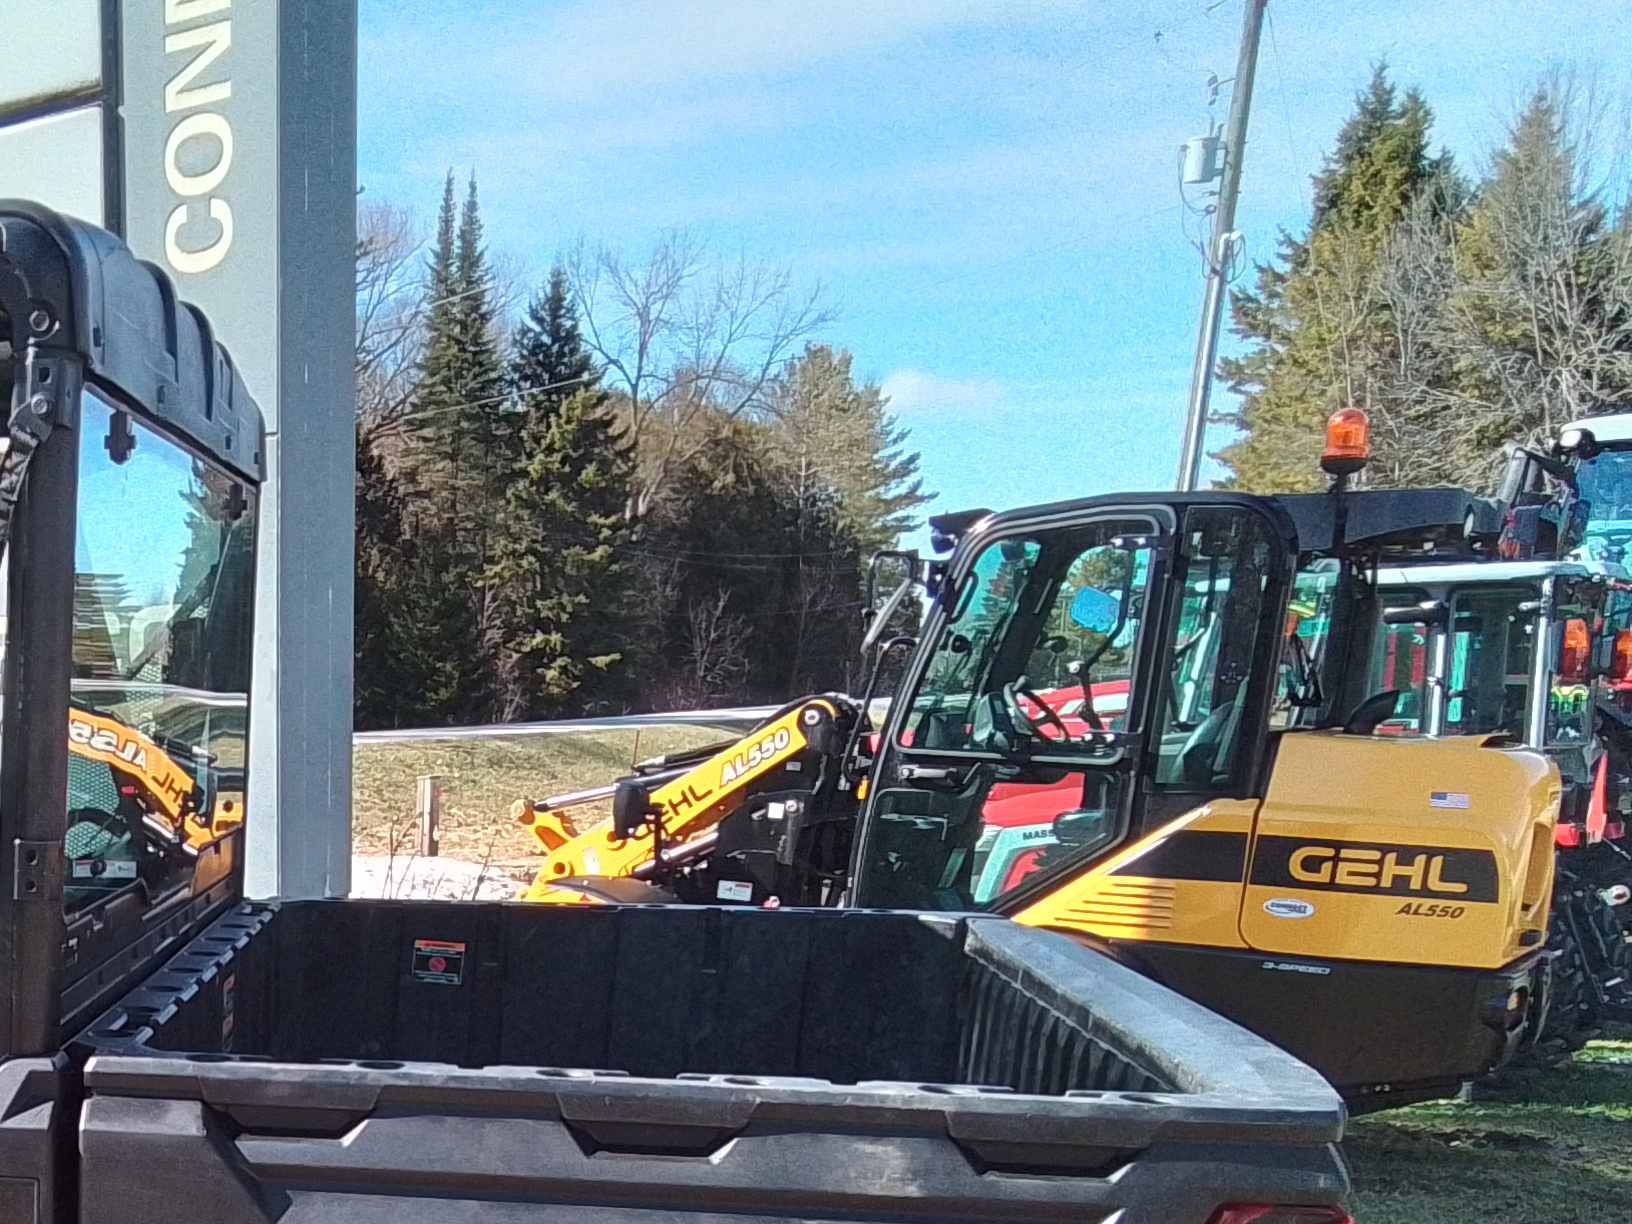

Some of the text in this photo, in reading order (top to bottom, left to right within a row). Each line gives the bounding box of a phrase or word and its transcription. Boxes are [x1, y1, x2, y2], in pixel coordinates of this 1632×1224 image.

[718, 725, 790, 790] AL550
[1288, 846, 1468, 893] GEHL
[1394, 902, 1466, 919] AL550
